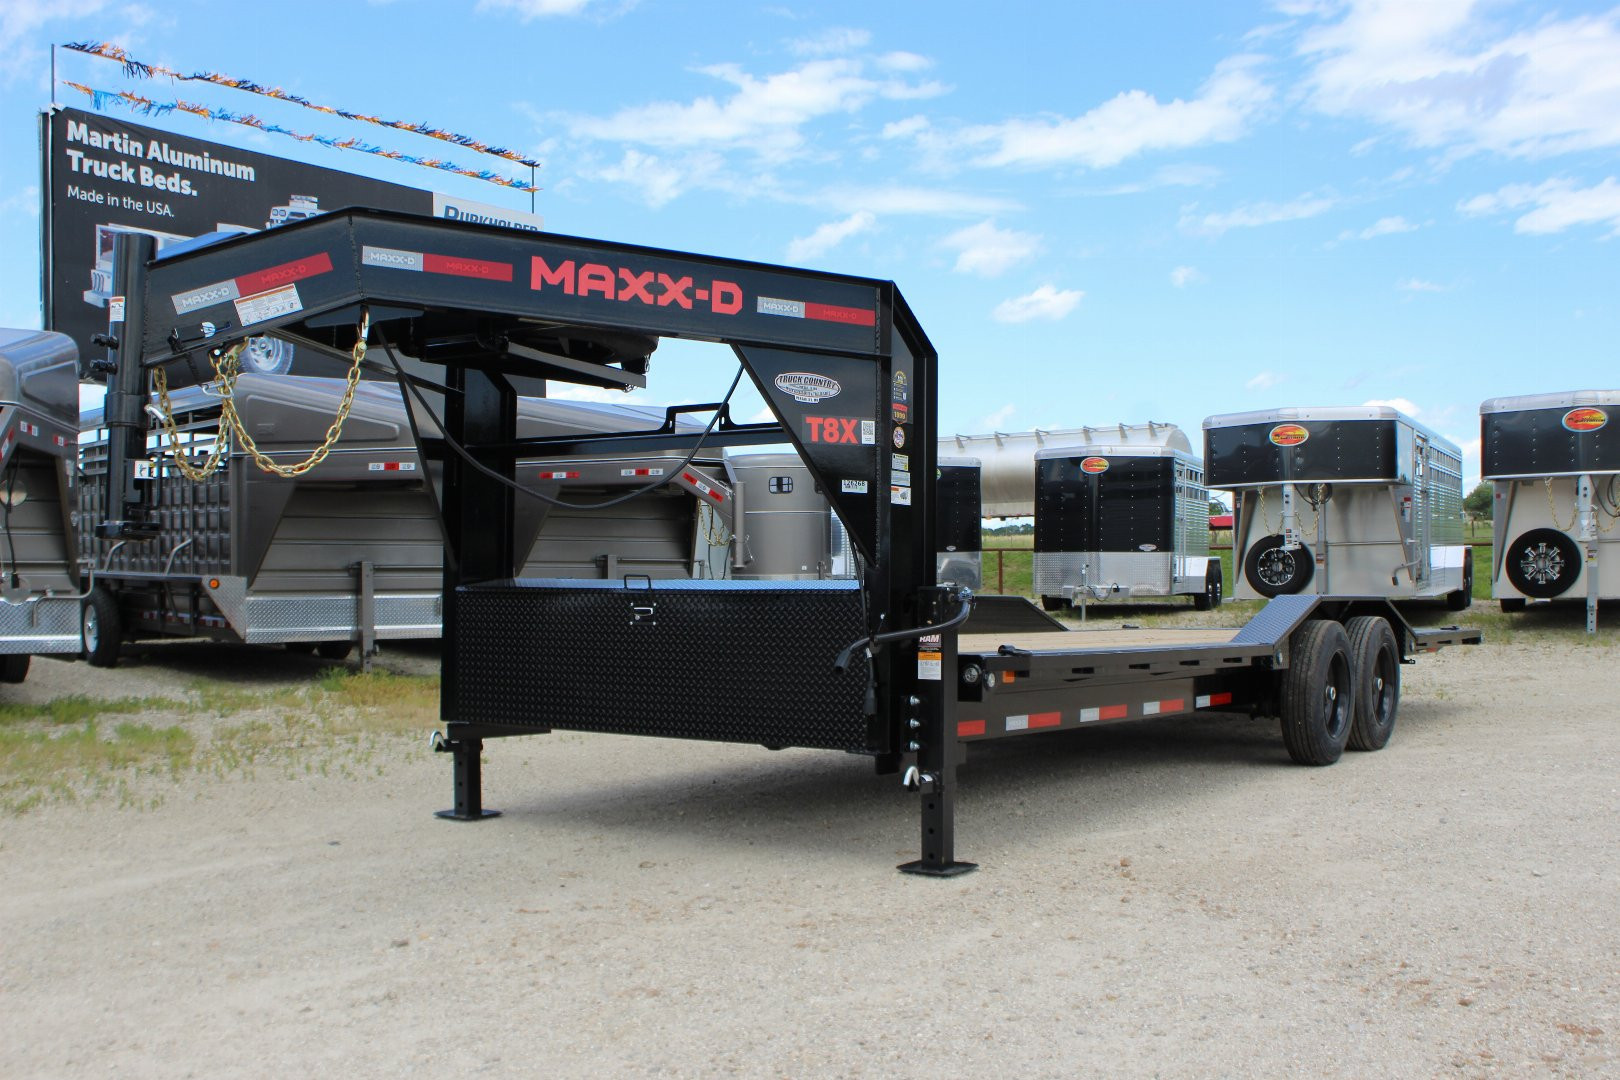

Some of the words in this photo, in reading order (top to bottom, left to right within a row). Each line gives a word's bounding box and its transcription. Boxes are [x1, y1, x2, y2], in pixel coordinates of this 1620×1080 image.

[67, 119, 143, 158] Martin
[147, 140, 255, 181] Aluminum
[66, 149, 136, 184] Truck
[139, 165, 198, 196] Beds.
[67, 184, 104, 204] Made
[107, 192, 119, 207] in
[122, 196, 143, 212] the
[146, 200, 175, 218] USA.
[370, 252, 415, 265] MAXX-D
[446, 262, 489, 274] MAXX-D
[181, 286, 230, 308] MAXX-D
[261, 264, 306, 284] MAXX-D
[530, 255, 743, 315] MAXX-D
[763, 302, 799, 313] MAXX-D
[780, 375, 802, 384] TRUCK
[803, 376, 835, 389] COUNTRY
[805, 416, 859, 444] T8X
